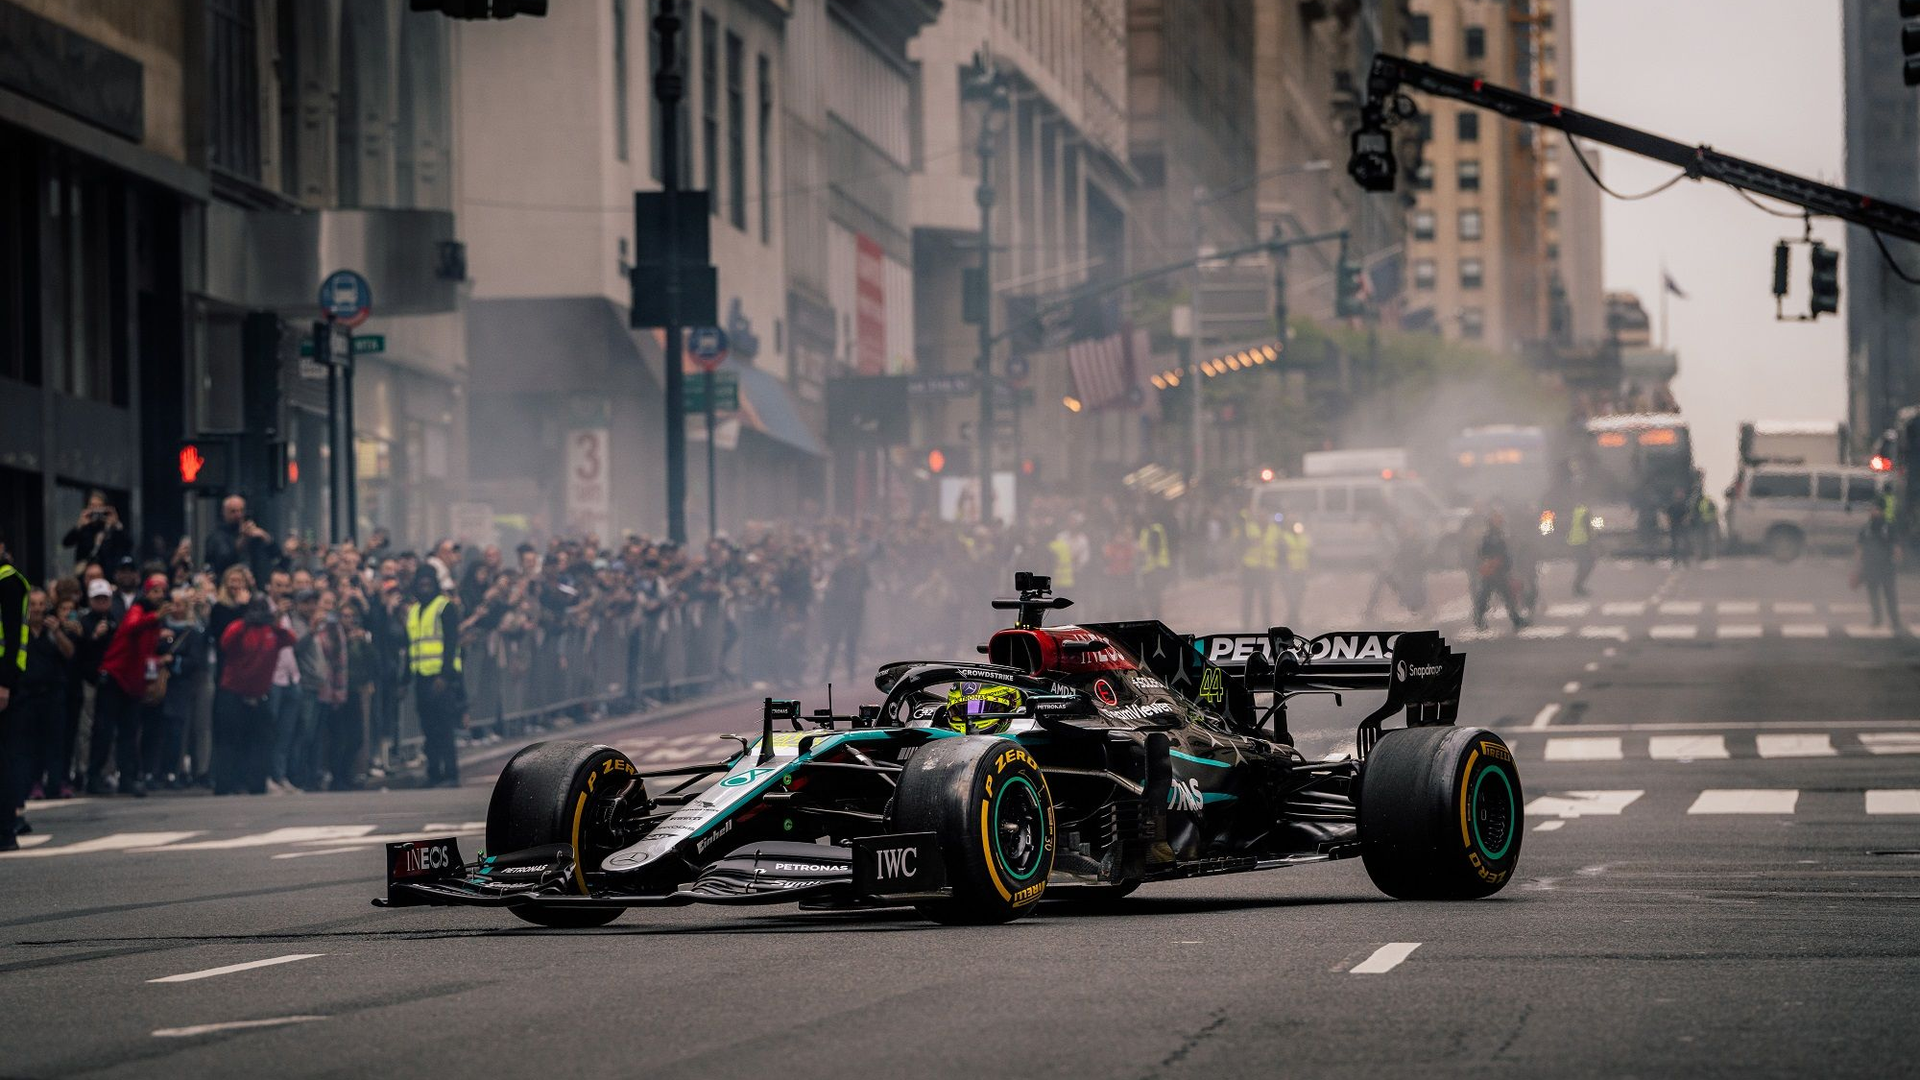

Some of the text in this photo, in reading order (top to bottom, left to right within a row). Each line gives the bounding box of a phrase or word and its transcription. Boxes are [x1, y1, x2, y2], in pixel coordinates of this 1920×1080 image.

[577, 433, 599, 480] 3
[962, 669, 1014, 681] CROWDSTRIKE
[1200, 668, 1223, 703] 44
[1051, 681, 1070, 697] AMD
[913, 708, 933, 719] G42
[1480, 741, 1510, 763] PIRELLI
[587, 758, 635, 792] P ZER
[985, 749, 1038, 798] P ZERO
[697, 819, 732, 855] Einhell
[406, 845, 449, 872] INEOS
[501, 864, 549, 874] PETRONAS
[775, 863, 849, 872] PETRONAS
[876, 847, 917, 880] IWC
